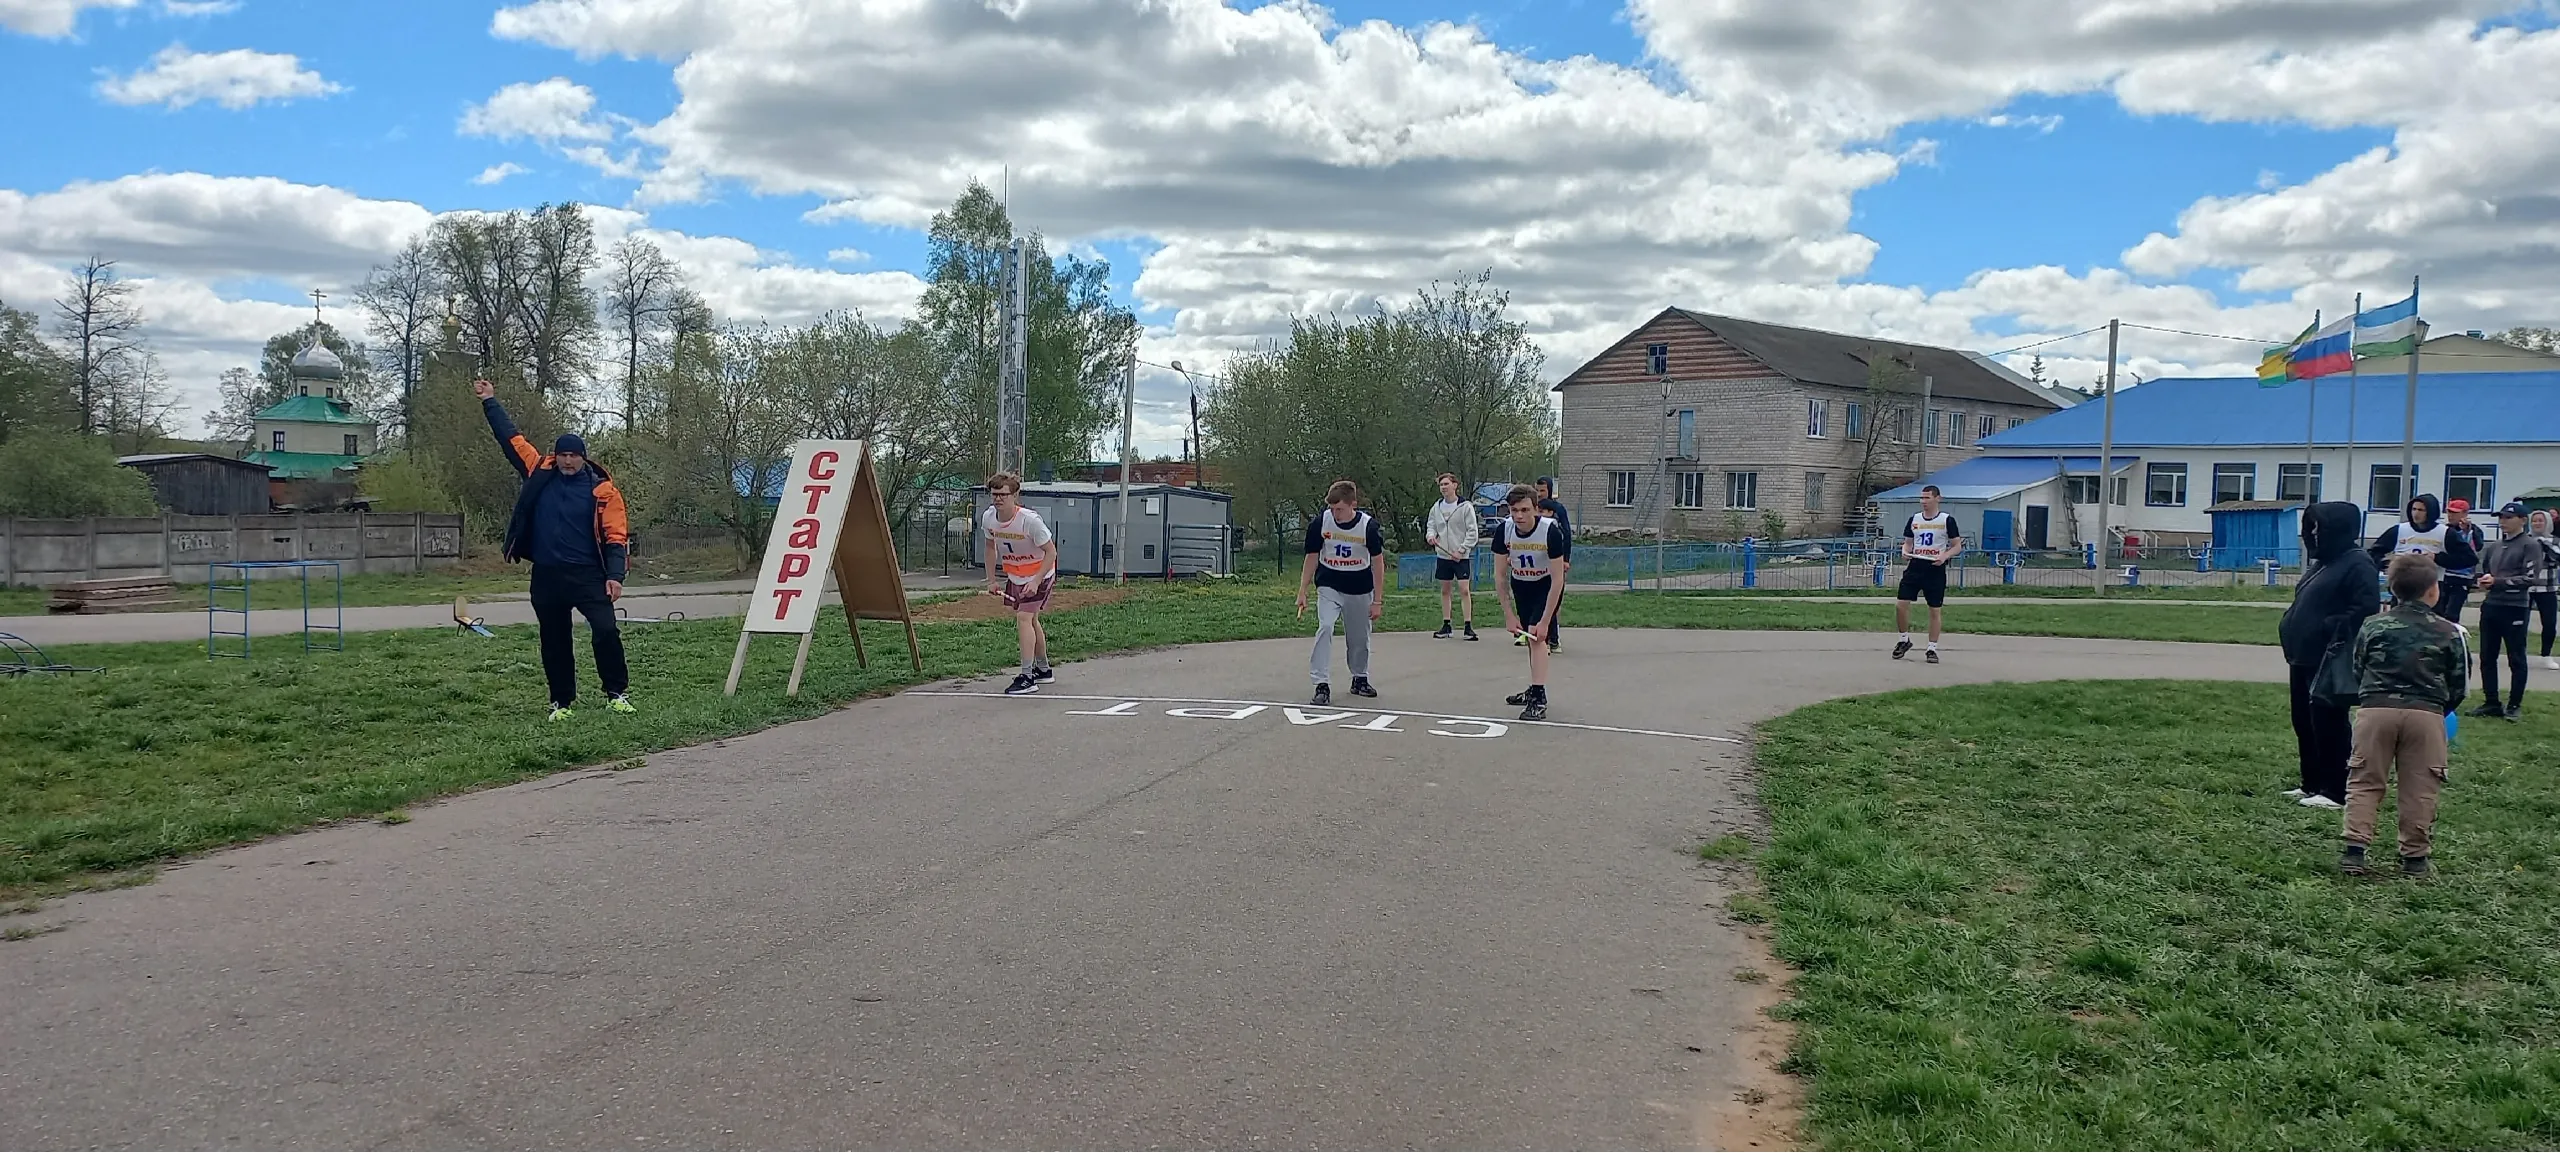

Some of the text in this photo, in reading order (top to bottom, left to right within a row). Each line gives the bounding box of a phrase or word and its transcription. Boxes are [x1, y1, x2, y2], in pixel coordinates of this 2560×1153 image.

[1919, 532, 1934, 546] 13
[1003, 542, 1014, 554] 7
[1334, 544, 1352, 558] 15
[1517, 554, 1535, 568] 11
[1065, 701, 1509, 739] СТАРТ
